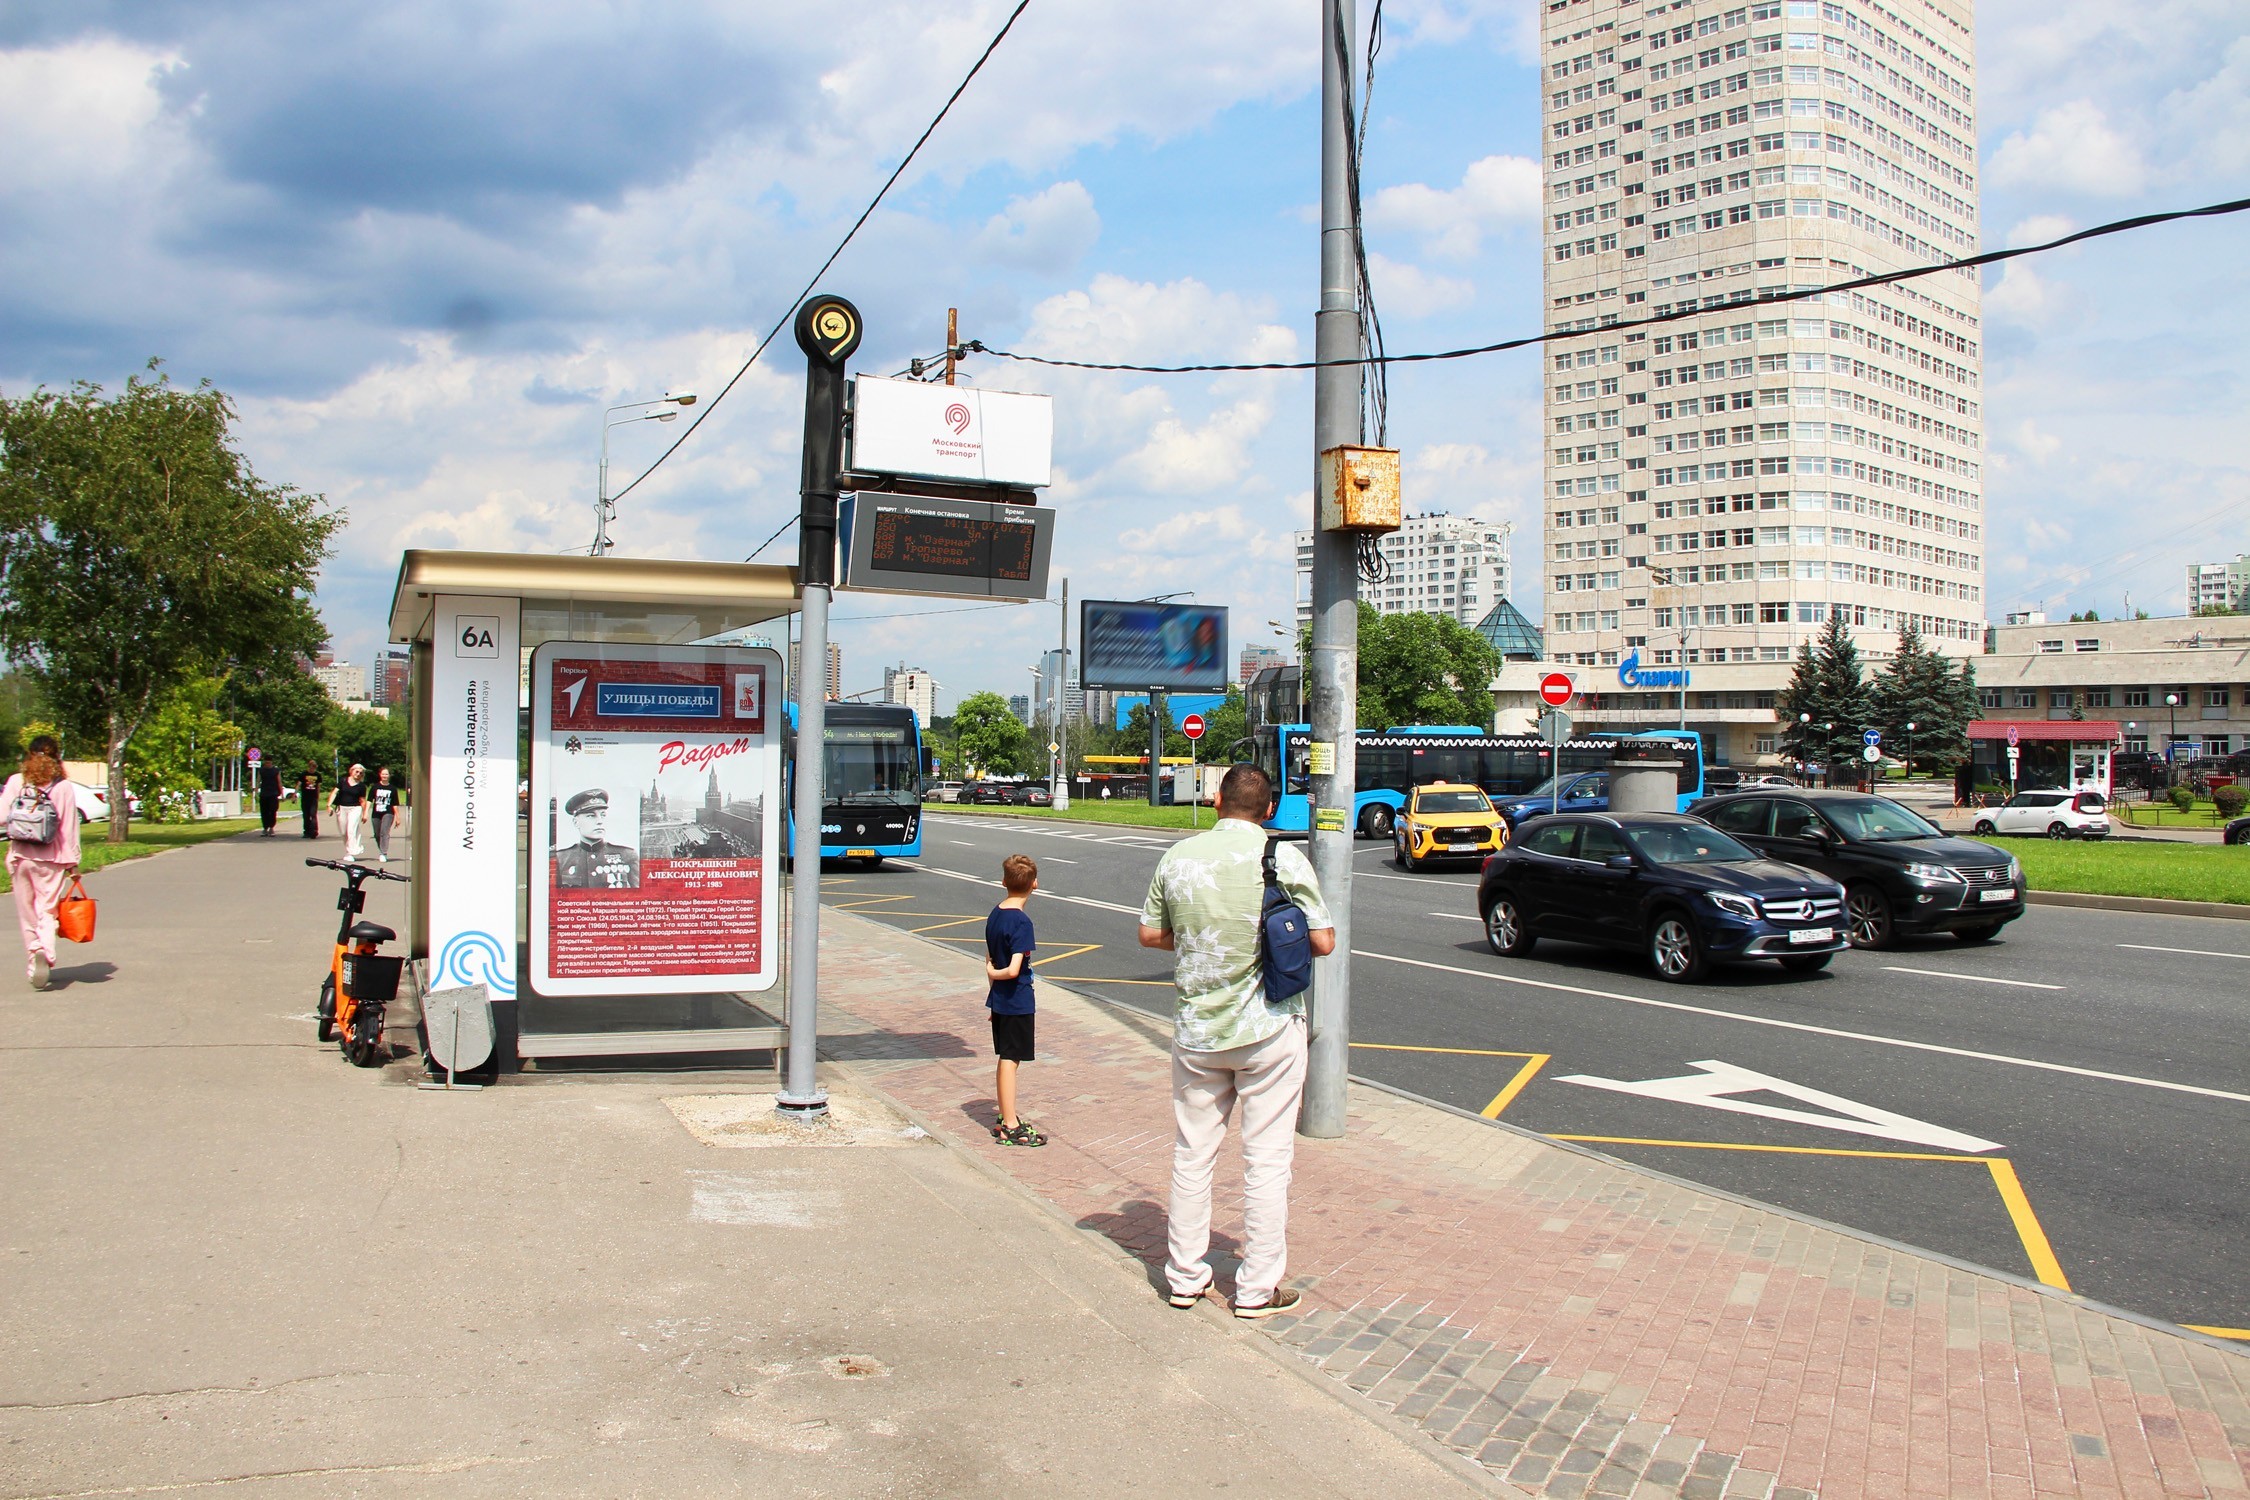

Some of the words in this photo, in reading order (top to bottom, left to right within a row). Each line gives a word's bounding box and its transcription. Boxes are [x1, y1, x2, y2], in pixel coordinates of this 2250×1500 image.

[932, 438, 982, 448] Московский
[936, 449, 976, 458] транспорт
[905, 507, 936, 516] Конечная
[876, 522, 896, 532] 250
[981, 522, 1032, 534] 07.07.25
[905, 543, 963, 555] Тропарево
[873, 550, 893, 559] 667
[1017, 562, 1029, 570] 10
[998, 568, 1029, 579] Табло
[560, 667, 588, 675] Первые
[604, 694, 655, 707] УЛИЦЫ
[658, 695, 714, 707] ПОБЕДЫ
[479, 680, 490, 758] Yugo-Zapadnaya
[464, 680, 478, 797] «Юго-Западная»
[659, 737, 750, 774] Рядом
[479, 759, 489, 789] Metro
[462, 801, 476, 850] Метро
